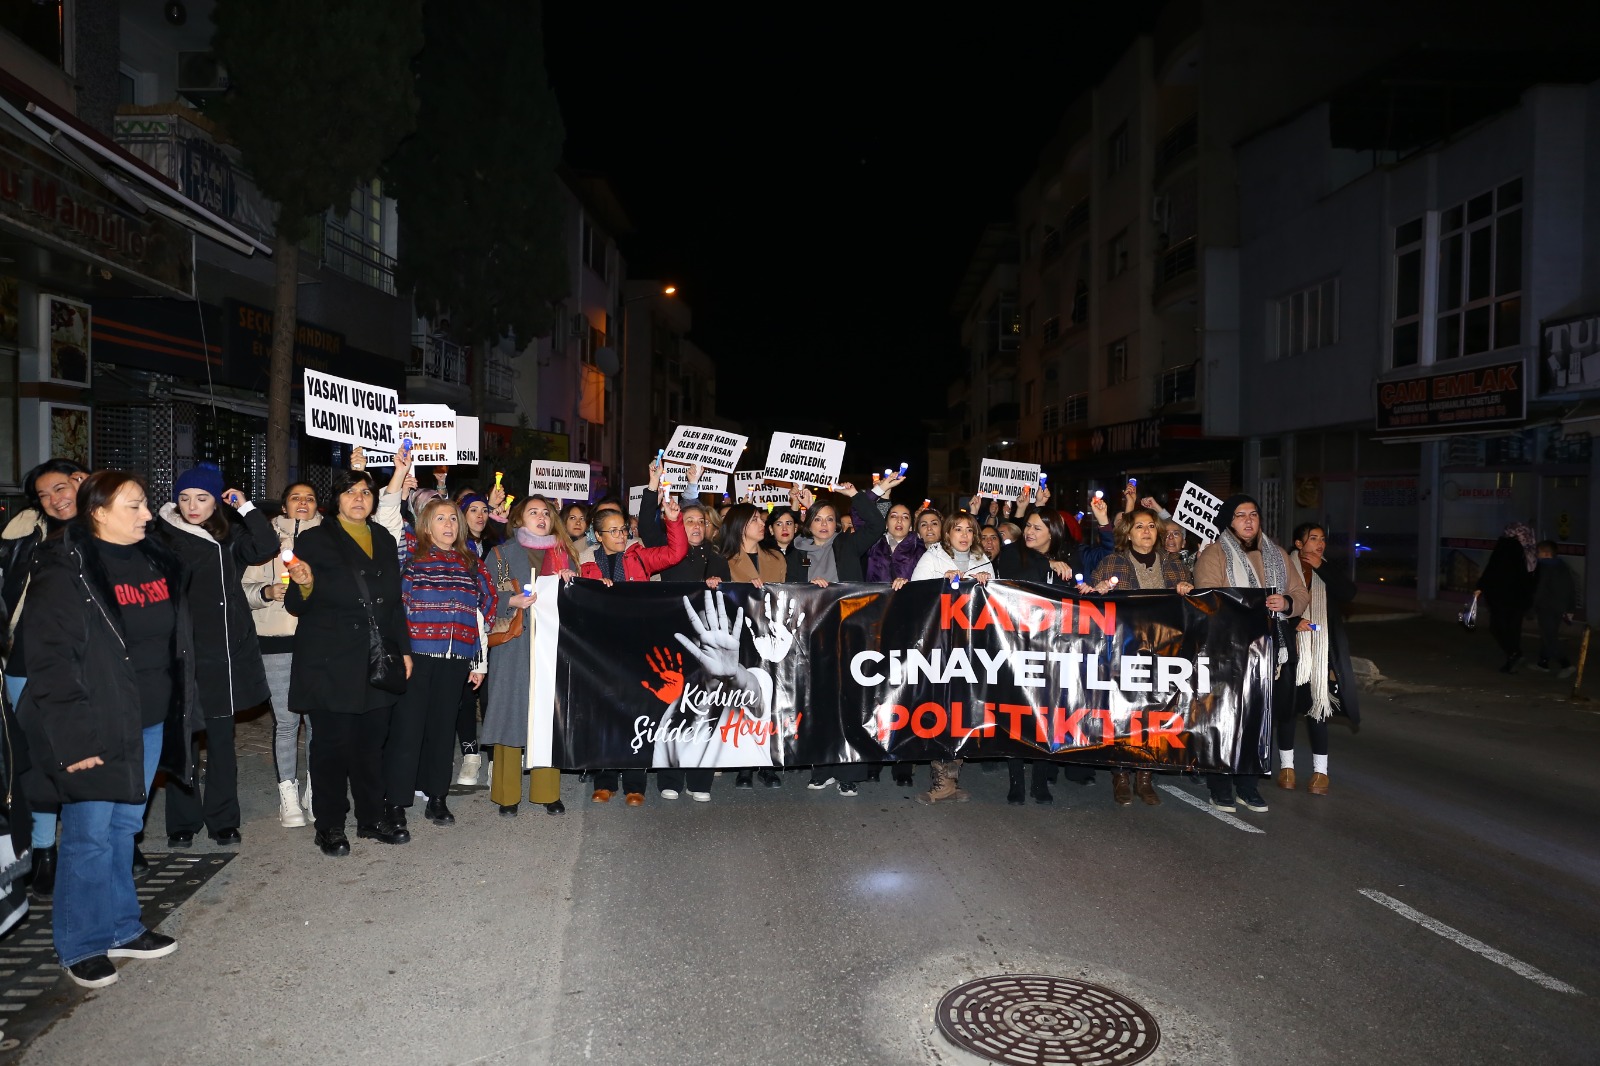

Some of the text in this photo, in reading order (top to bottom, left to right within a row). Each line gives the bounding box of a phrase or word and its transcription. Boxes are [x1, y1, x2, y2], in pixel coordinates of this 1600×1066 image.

[307, 375, 398, 415] YASAYI UYGULA
[1380, 365, 1518, 409] ÇAM EMLAK
[311, 407, 395, 447] KADINI YAŞAT.
[398, 431, 422, 440] EĞİL,
[677, 439, 696, 449] ÖLEN
[697, 441, 710, 452] BİR
[682, 428, 738, 447] ÖLEN BİR KADIN
[789, 435, 826, 453] ÖFKEMİZİ
[417, 453, 448, 462] GELİR.
[667, 448, 685, 459] ÖLEN
[686, 451, 700, 461] BİR
[780, 450, 827, 470] ÖRGÜTLEDİK,
[736, 471, 753, 481] TEK
[764, 466, 789, 479] HESAP
[982, 465, 1010, 479] KADININ
[980, 481, 1004, 495] KADINA
[759, 494, 789, 503] KADIN
[1186, 487, 1222, 512] AKLA
[1183, 499, 1213, 523] KOR
[940, 594, 1117, 636] KADIN
[679, 682, 759, 716] Kadına
[630, 715, 718, 755] Şiddete
